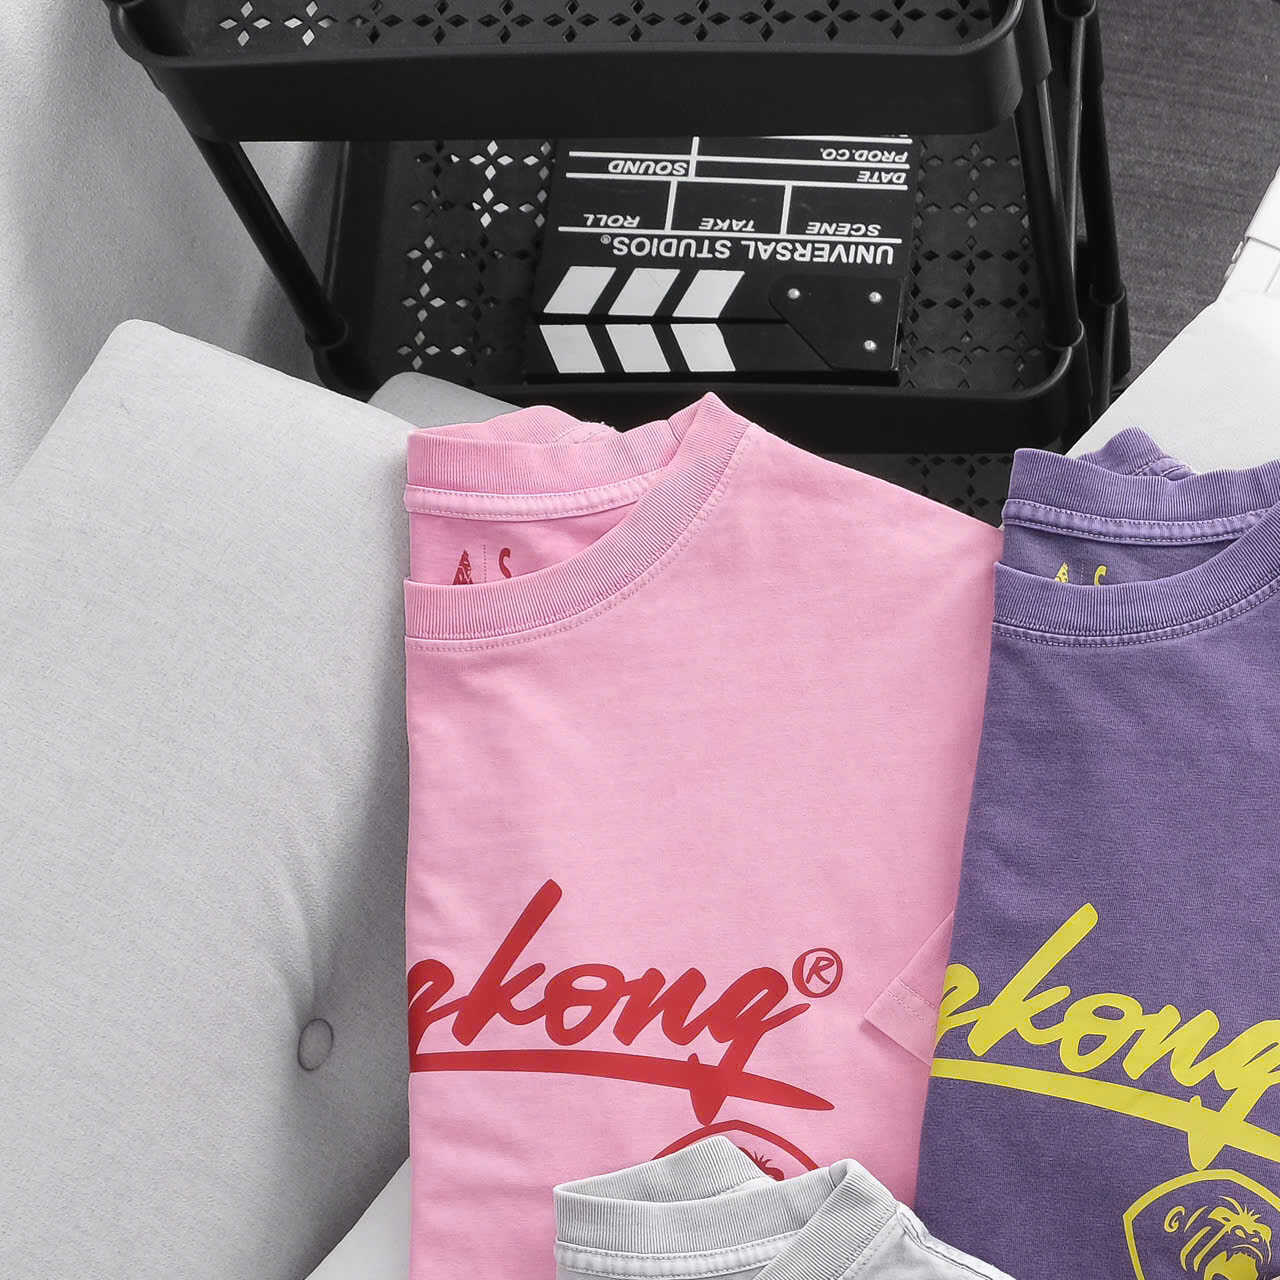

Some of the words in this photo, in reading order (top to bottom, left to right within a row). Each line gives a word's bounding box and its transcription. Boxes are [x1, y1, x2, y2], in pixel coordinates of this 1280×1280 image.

[819, 147, 908, 163] PROD.CO.
[608, 160, 689, 176] SOUND
[857, 170, 906, 184] DATE
[583, 213, 640, 228] ROLL
[699, 217, 756, 231] TAKE
[805, 222, 882, 237] SCENE
[740, 240, 894, 265] UNIVERSAL
